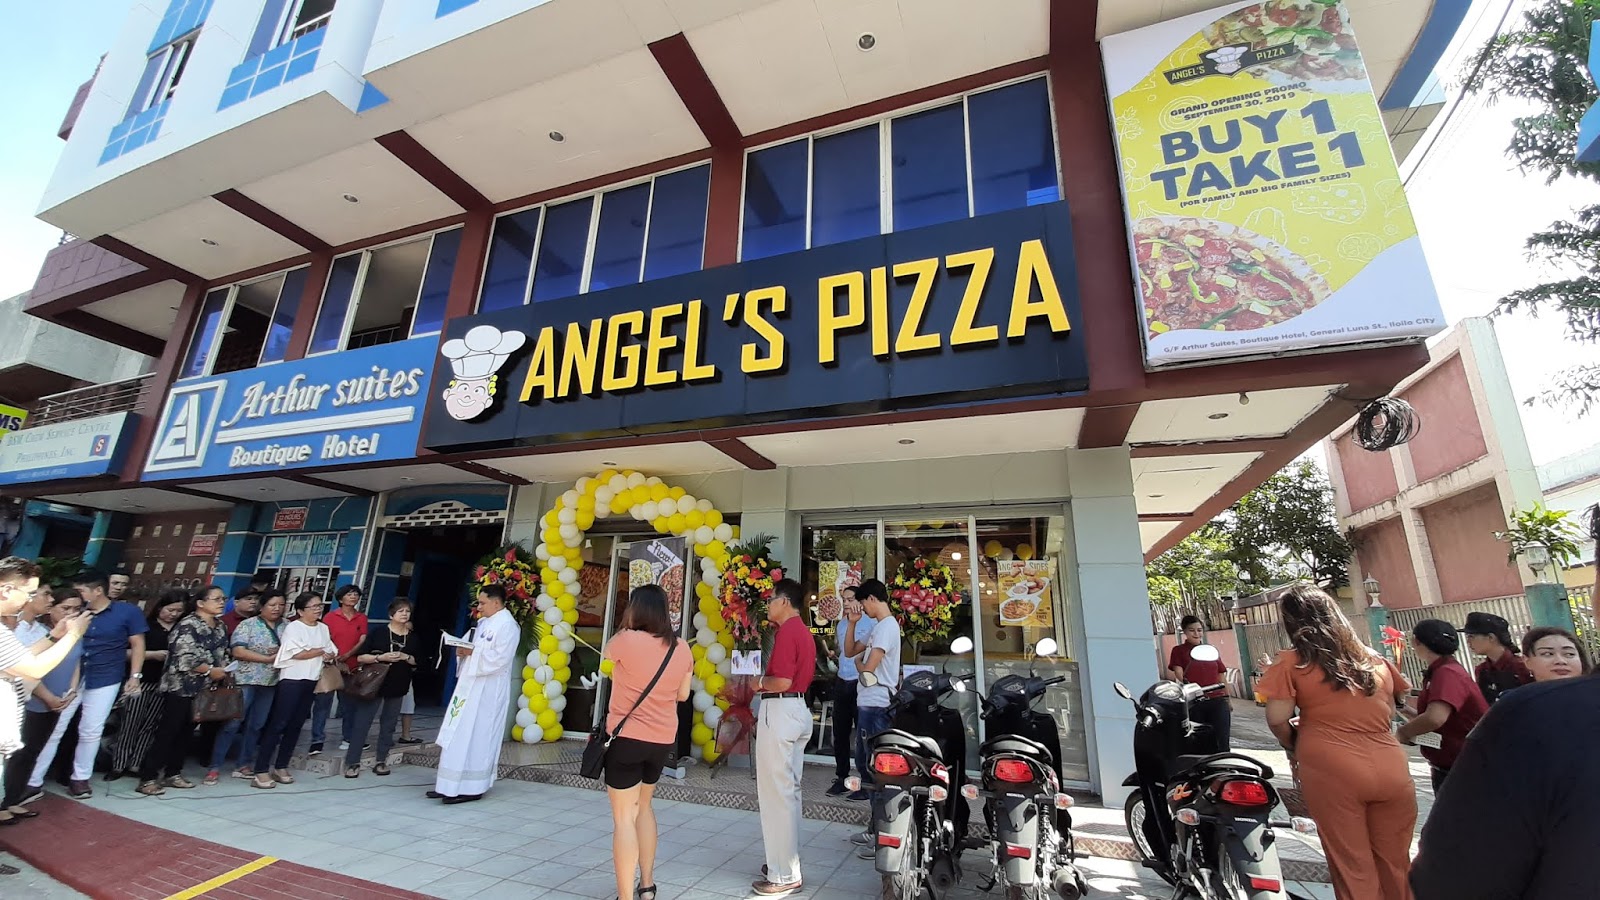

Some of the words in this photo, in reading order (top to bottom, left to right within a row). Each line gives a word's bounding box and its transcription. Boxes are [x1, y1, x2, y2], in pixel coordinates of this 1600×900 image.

[1171, 65, 1206, 81] ANGEL'S
[1256, 47, 1287, 61] PIZZA
[1170, 103, 1209, 117] GRAND
[1211, 91, 1262, 107] OPENING
[1263, 81, 1308, 96] PROMO
[1183, 103, 1243, 121] SEPTEMBER
[1265, 91, 1296, 103] 2019
[1160, 108, 1288, 165] BUY
[1300, 98, 1337, 135] 1
[1150, 141, 1321, 201] TAKE
[1327, 131, 1366, 169] 1
[1180, 199, 1201, 209] (FOR
[1202, 192, 1236, 203] FAMILY
[1238, 188, 1260, 197] AND
[1280, 177, 1318, 189] FAMILY
[1319, 171, 1352, 182] SIZES)
[518, 284, 788, 404] ANGEL'S
[818, 239, 1074, 366] PIZZA
[1163, 345, 1180, 354] G/F
[1181, 342, 1209, 352] Arthur
[1210, 339, 1239, 349] Suites,
[1240, 334, 1280, 346] Boutique
[1281, 331, 1308, 340] Hotel,
[1309, 327, 1346, 337] General
[1347, 324, 1370, 333] Luna
[1389, 319, 1414, 328] Iloilo
[1415, 317, 1436, 327] City
[220, 373, 332, 428] Arthur
[332, 365, 425, 408] suites
[229, 443, 313, 469] Boutique
[320, 432, 380, 460] Hotel
